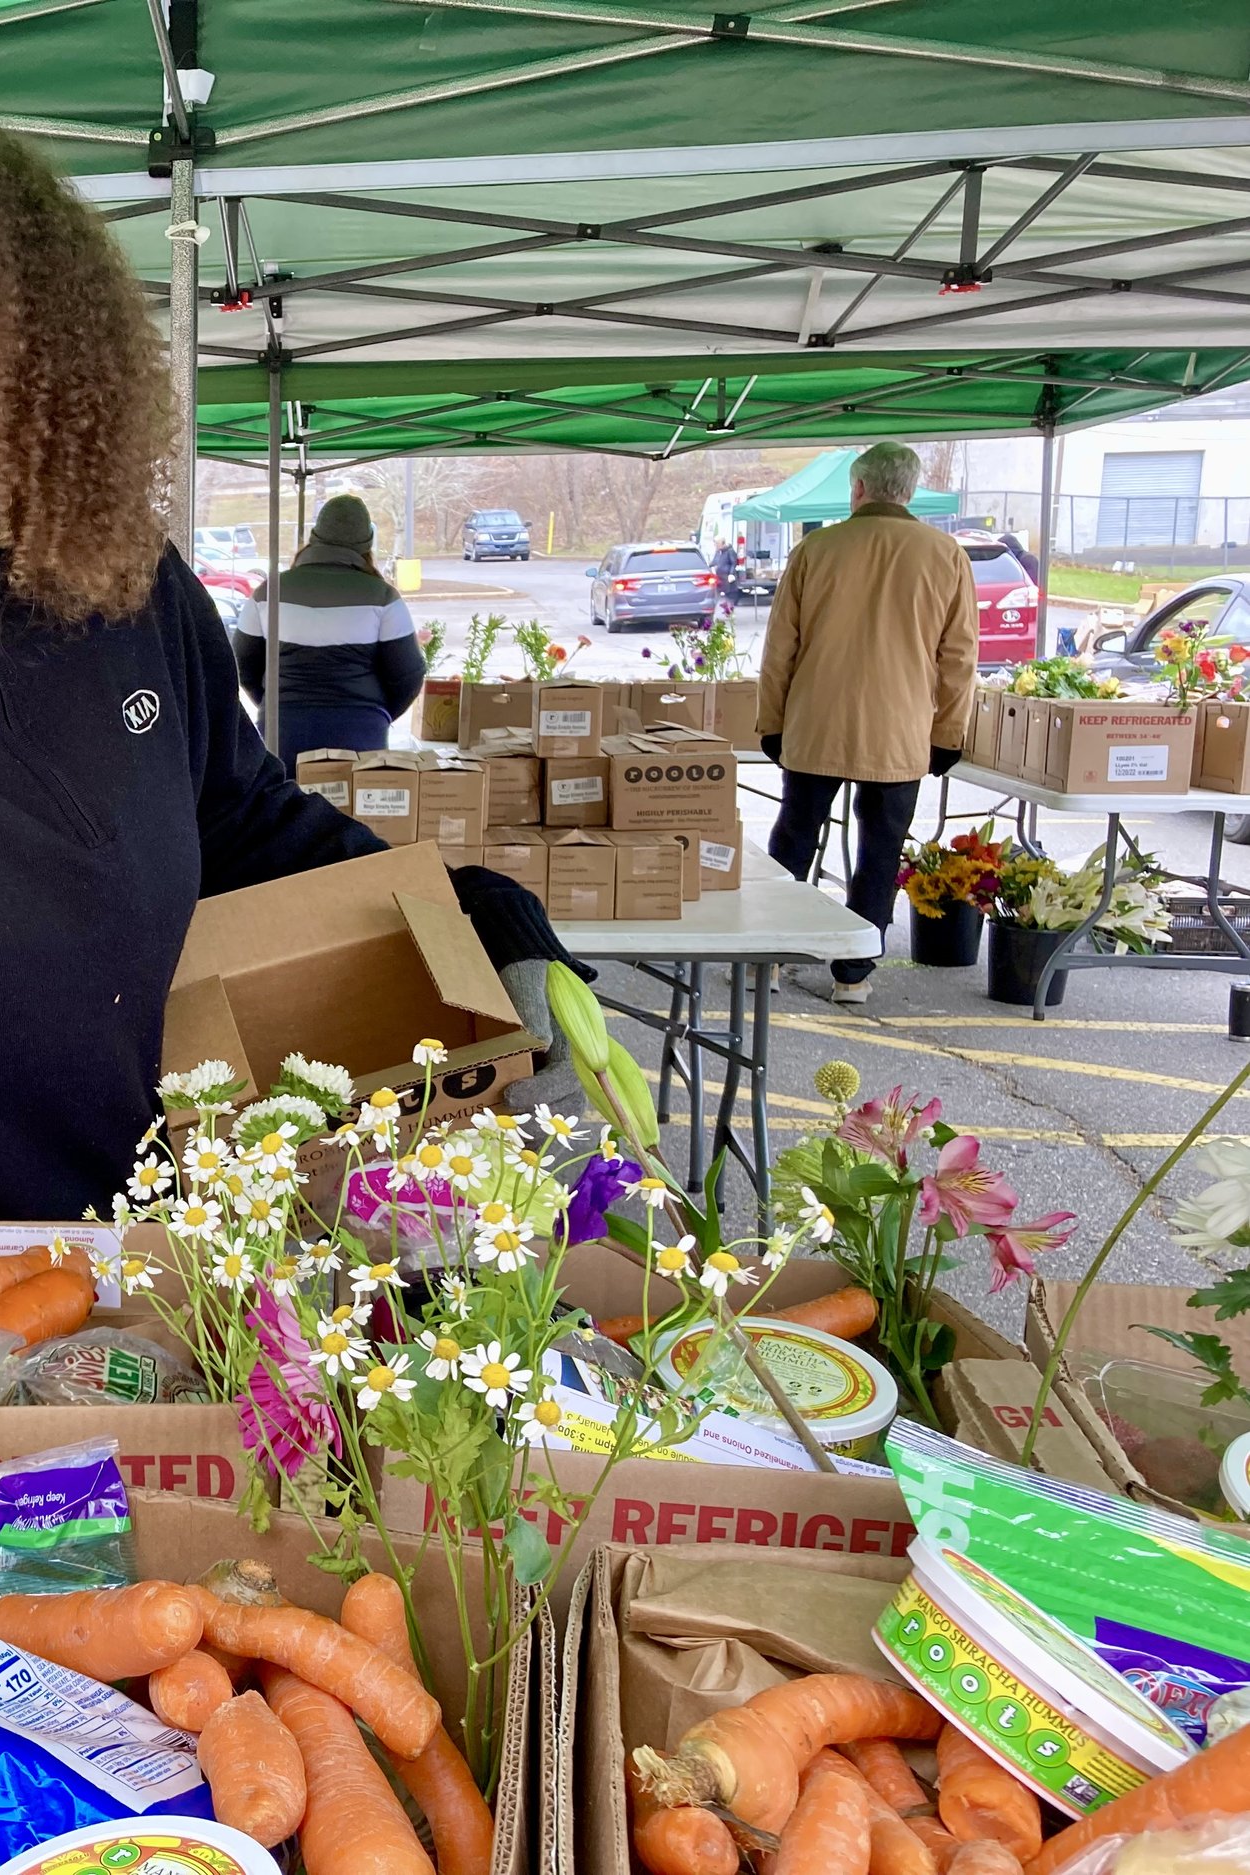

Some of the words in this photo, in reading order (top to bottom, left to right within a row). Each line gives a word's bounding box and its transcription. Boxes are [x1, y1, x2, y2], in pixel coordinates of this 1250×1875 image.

[125, 695, 156, 729] KIA
[1079, 715, 1108, 726] KEEP
[1111, 715, 1192, 726] REFRIGERATED
[62, 1236, 95, 1244] Almond
[758, 1344, 829, 1367] SRIRACHA
[760, 1339, 816, 1357] MANGO
[557, 1424, 586, 1442] 5:30p
[575, 1414, 612, 1435] January
[703, 1428, 720, 1442] and
[721, 1435, 753, 1455] Onions
[594, 1438, 616, 1453] 4pm
[45, 1493, 66, 1504] Keep
[612, 1498, 916, 1557] REFRIGE
[41, 1665, 57, 1679] WHEAT
[914, 1592, 951, 1633] MANGO
[950, 1629, 1020, 1696] SRIRACHA
[1020, 1690, 1091, 1748] HUMMUS
[5, 1668, 32, 1693] 170
[902, 1617, 1062, 1757] roots
[919, 1672, 950, 1699] good
[978, 1721, 1036, 1773] necessary
